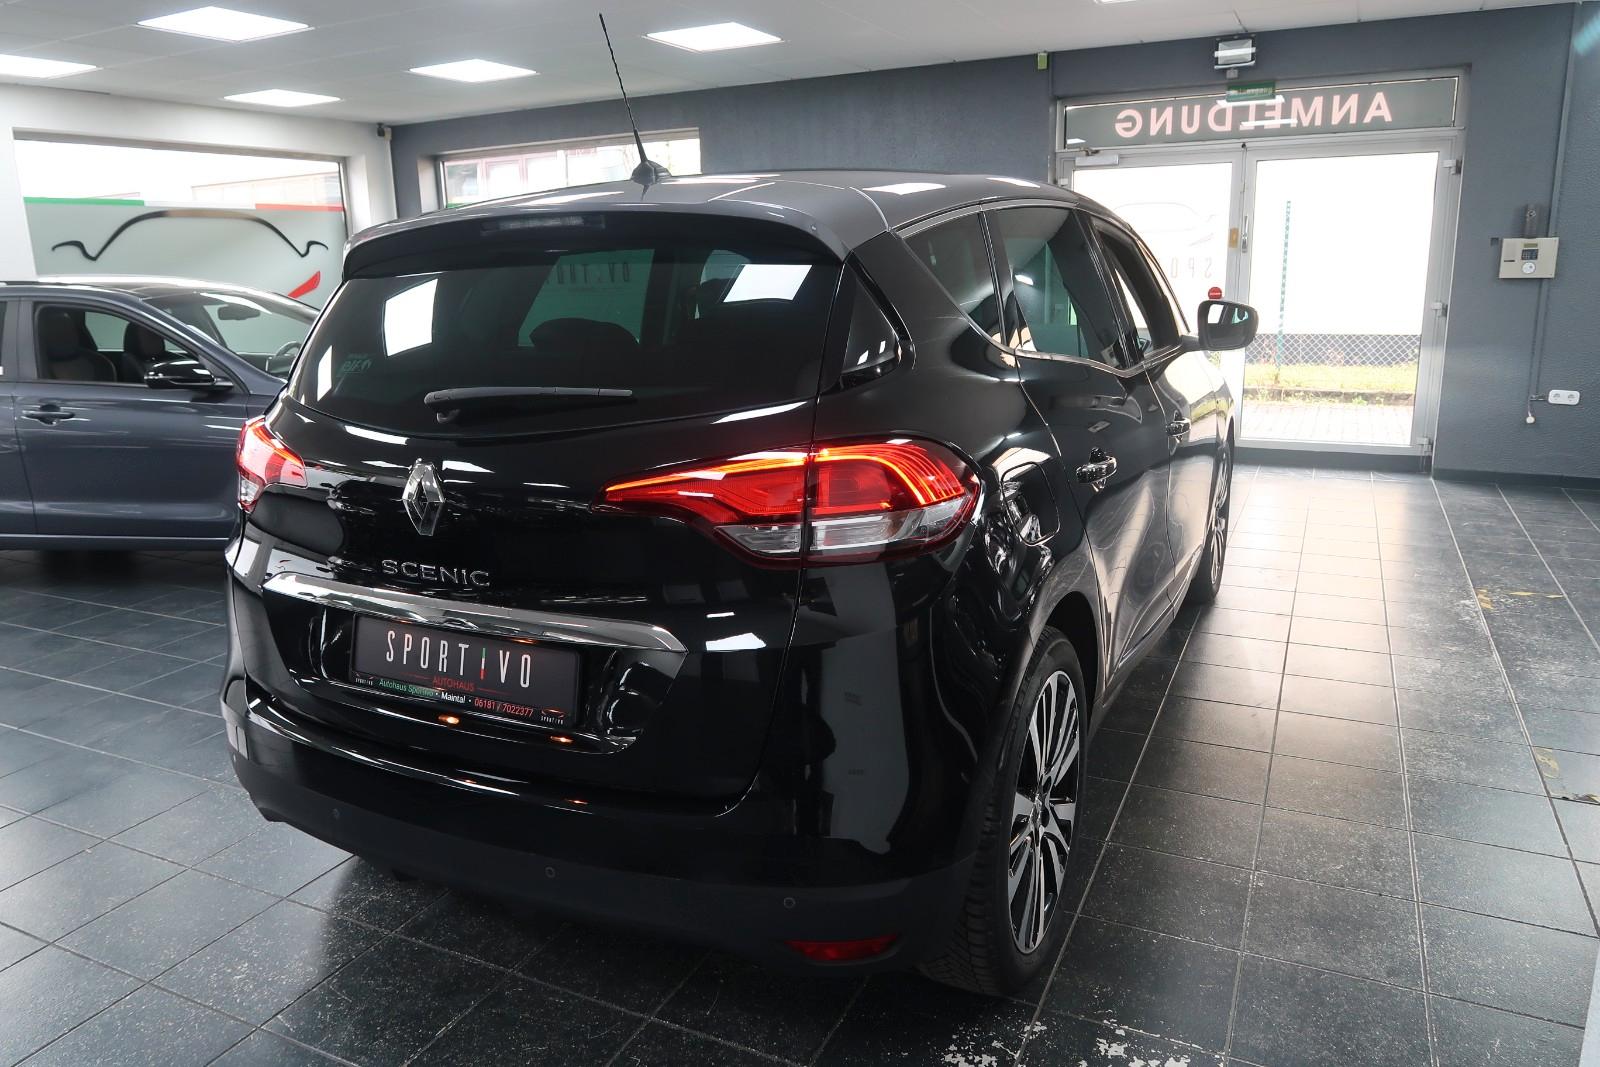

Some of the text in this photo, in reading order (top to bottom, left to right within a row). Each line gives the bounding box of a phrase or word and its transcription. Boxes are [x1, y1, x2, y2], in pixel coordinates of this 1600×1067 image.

[381, 559, 490, 587] SCENIC
[386, 630, 532, 688] SPORTIVO
[379, 678, 407, 692] Autohaus
[408, 684, 434, 698] Sportivo
[441, 691, 466, 704] Maintal
[474, 698, 495, 710] 06181
[502, 703, 534, 718] 7022377
[433, 675, 475, 692] AUTOHAUS
